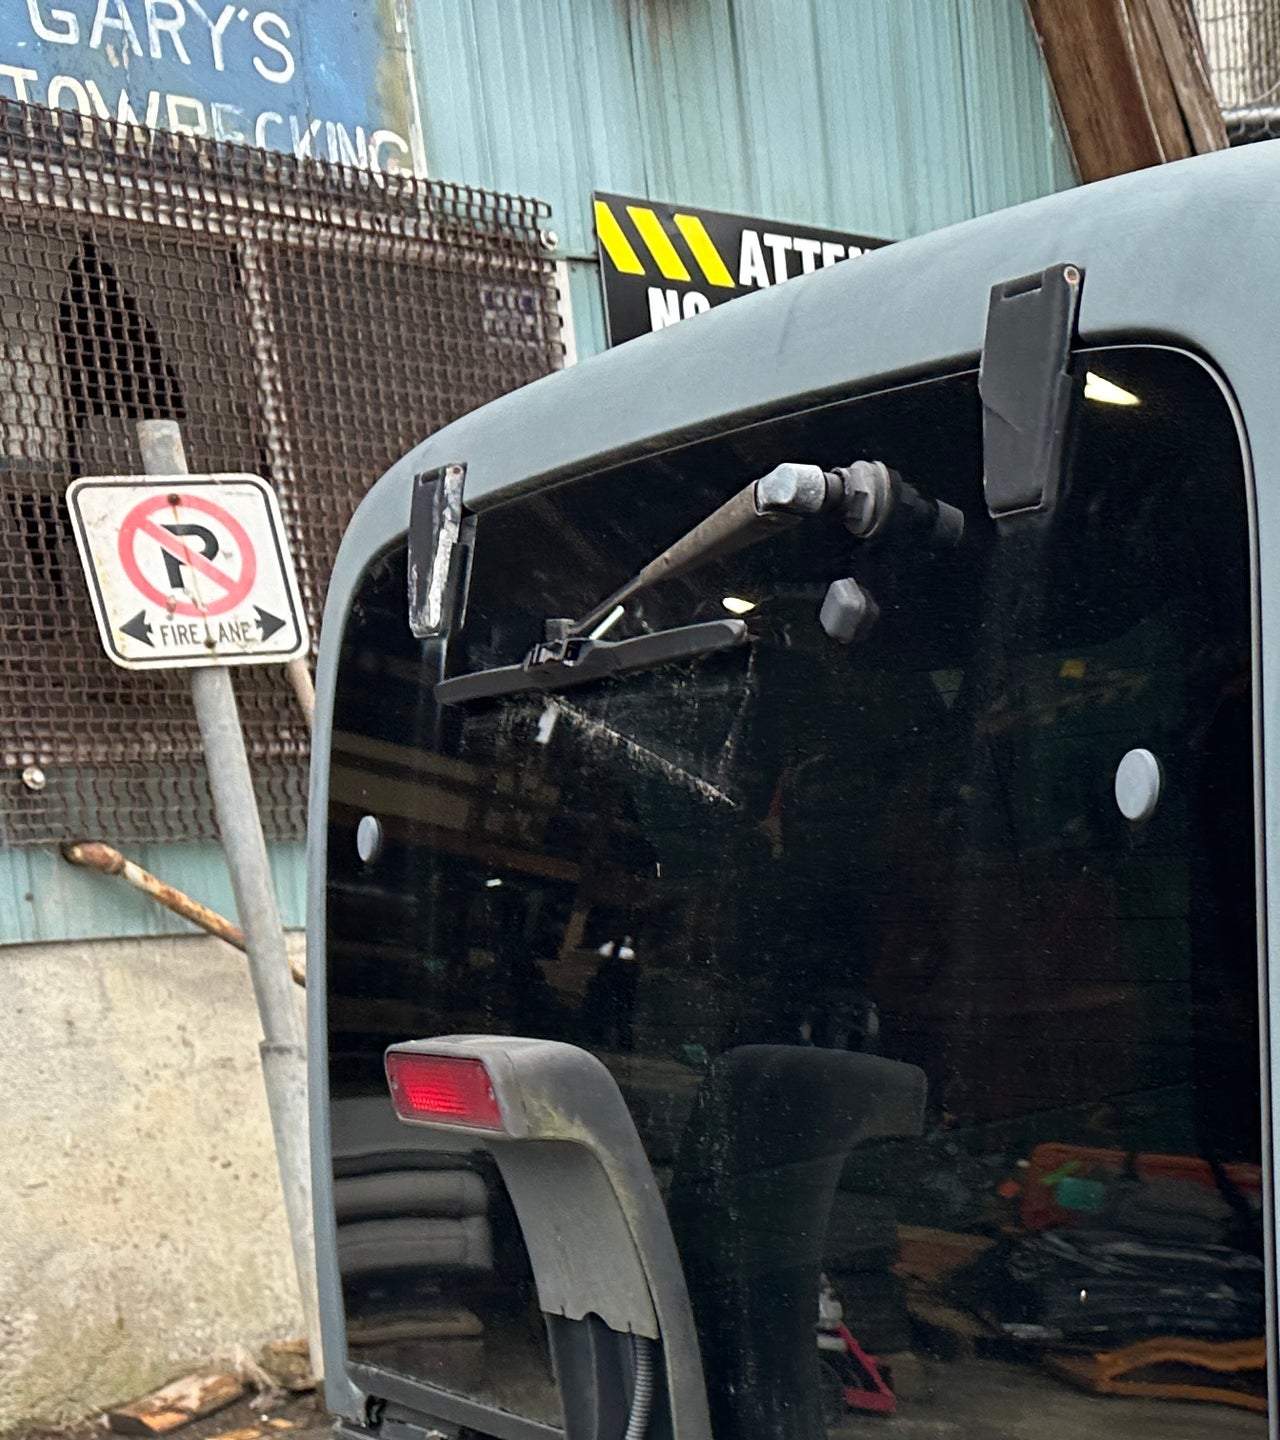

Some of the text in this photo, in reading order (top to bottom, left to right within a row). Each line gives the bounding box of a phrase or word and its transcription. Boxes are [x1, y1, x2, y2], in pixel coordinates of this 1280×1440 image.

[27, 0, 296, 84] GARY'S
[160, 621, 257, 647] FIRE LANE
